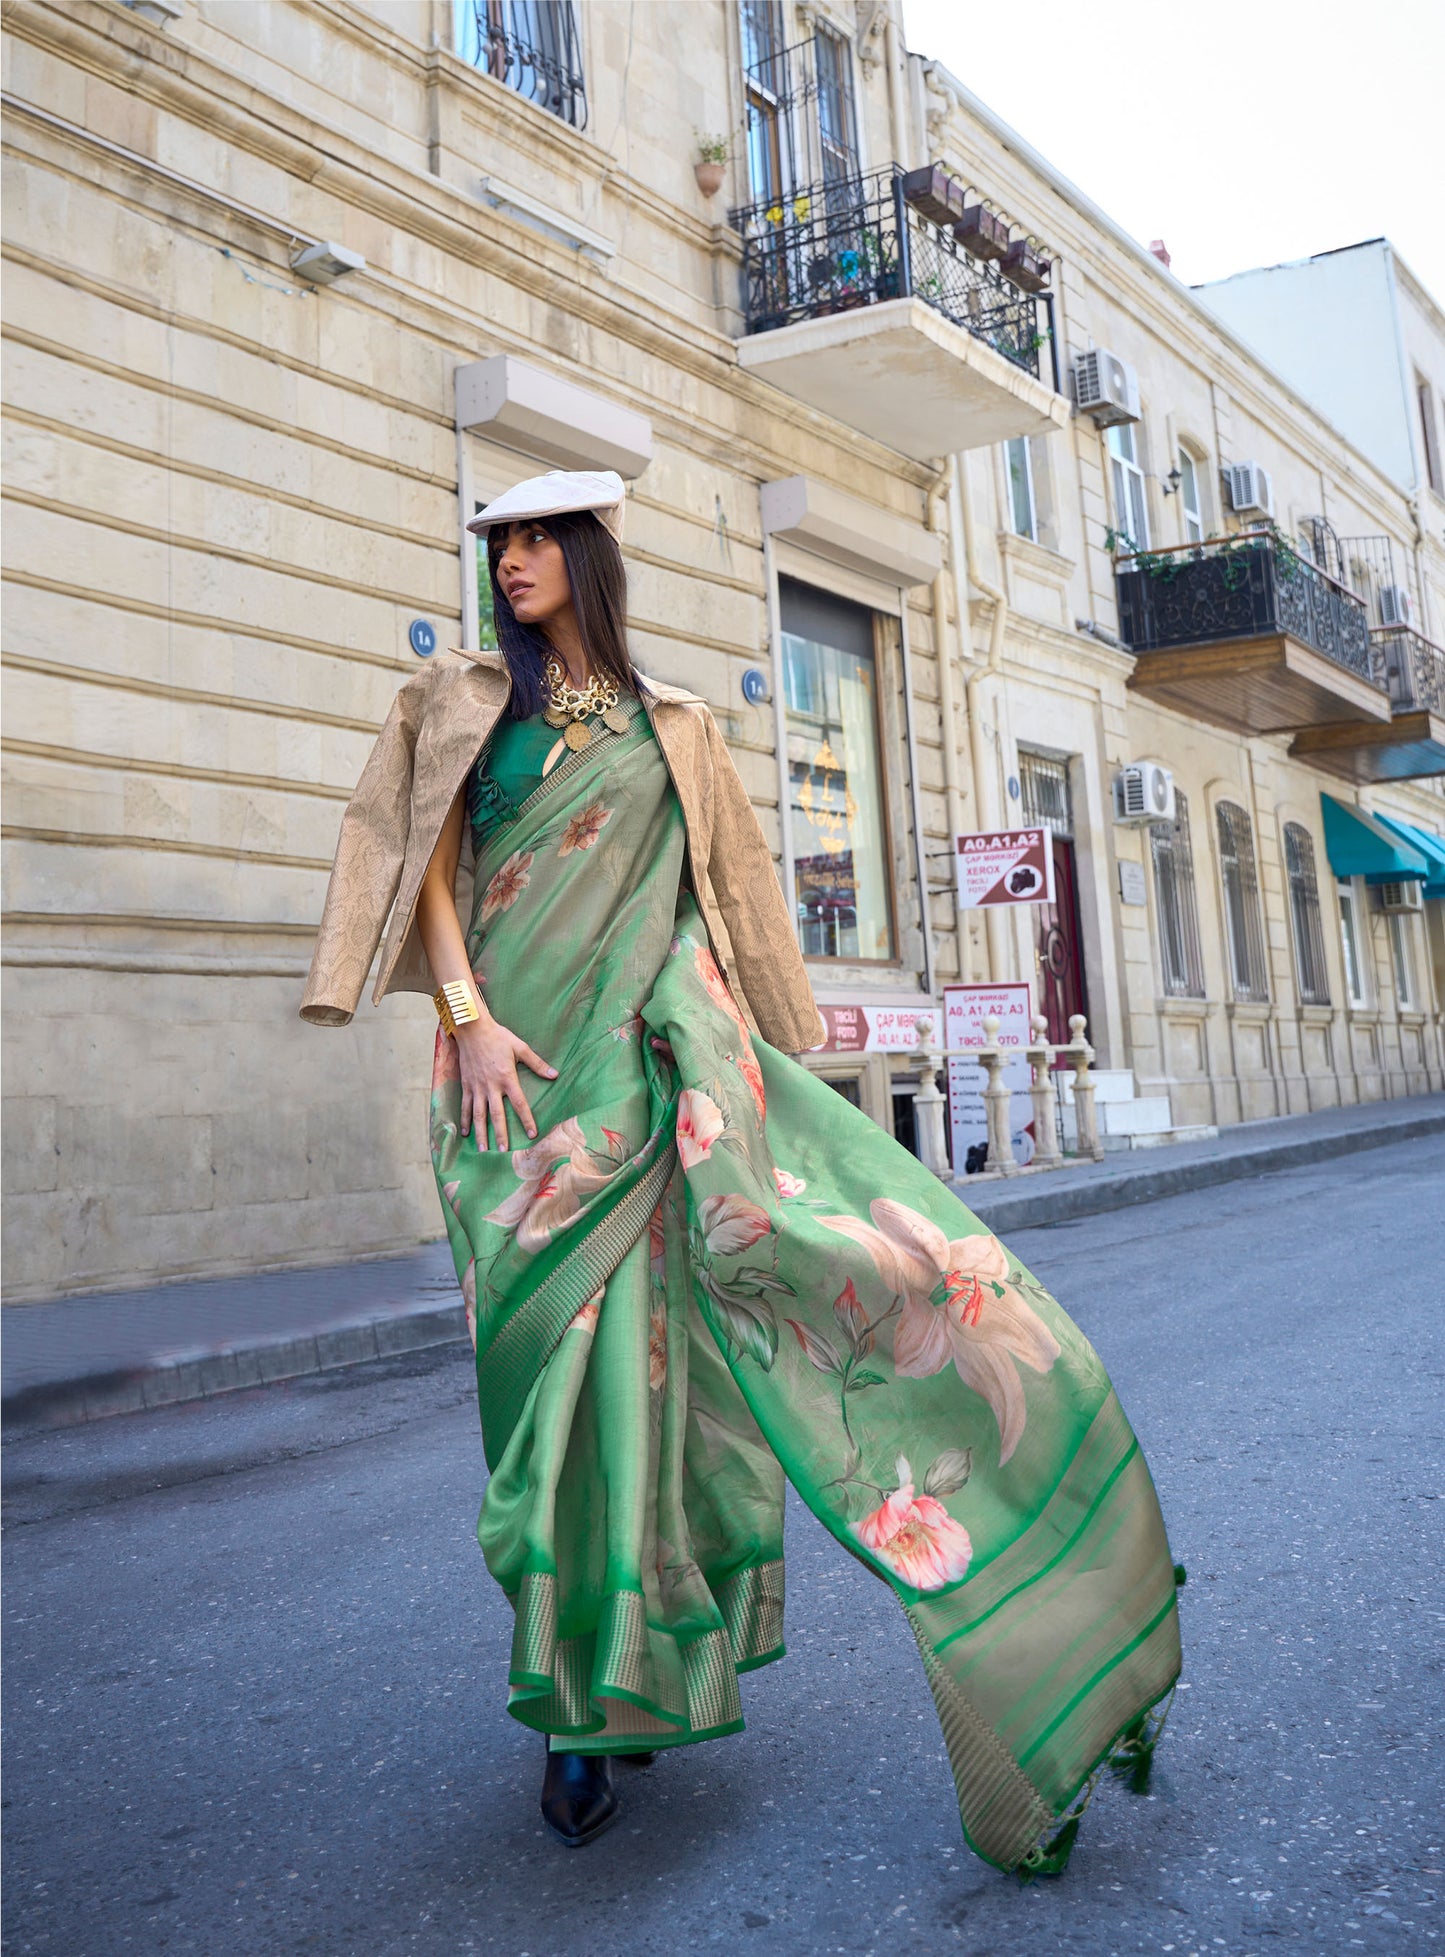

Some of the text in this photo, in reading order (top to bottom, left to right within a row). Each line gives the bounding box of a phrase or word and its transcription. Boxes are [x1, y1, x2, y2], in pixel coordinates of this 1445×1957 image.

[418, 630, 431, 647] 1A
[963, 833, 1039, 852] A0,A1,A2
[966, 865, 1000, 876] XEROX
[1009, 1003, 1024, 1014] A3
[876, 1013, 895, 1030] ÇAP
[836, 1026, 857, 1039] FOTO
[998, 1035, 1019, 1046] OTO
